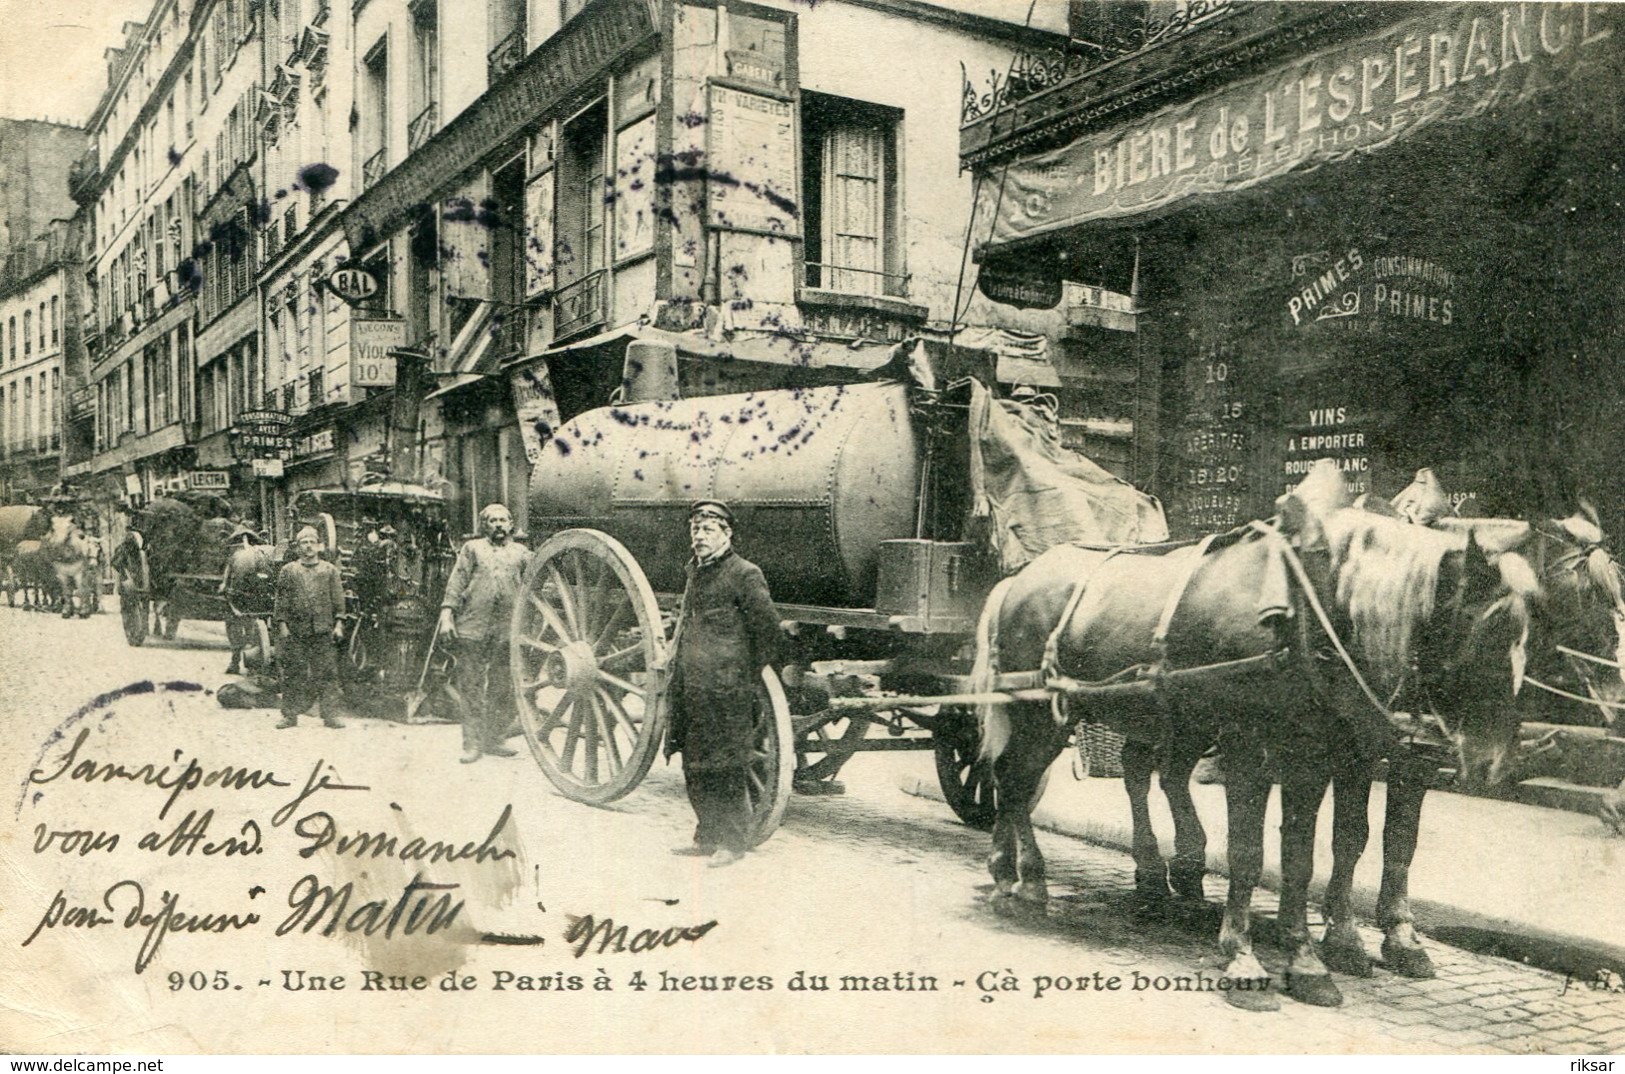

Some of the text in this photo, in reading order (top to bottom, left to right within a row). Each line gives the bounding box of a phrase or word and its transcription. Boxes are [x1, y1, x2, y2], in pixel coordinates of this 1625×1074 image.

[1093, 117, 1197, 196] BIÈRE
[1210, 106, 1249, 159] de
[337, 271, 373, 295] BAL
[1287, 248, 1363, 326] PRIMES
[1373, 283, 1453, 326] PRIMES
[357, 341, 397, 360] VIOLO
[1309, 407, 1347, 427] VINS
[242, 435, 293, 449] PRIMES
[1301, 429, 1365, 450] EMPORTER
